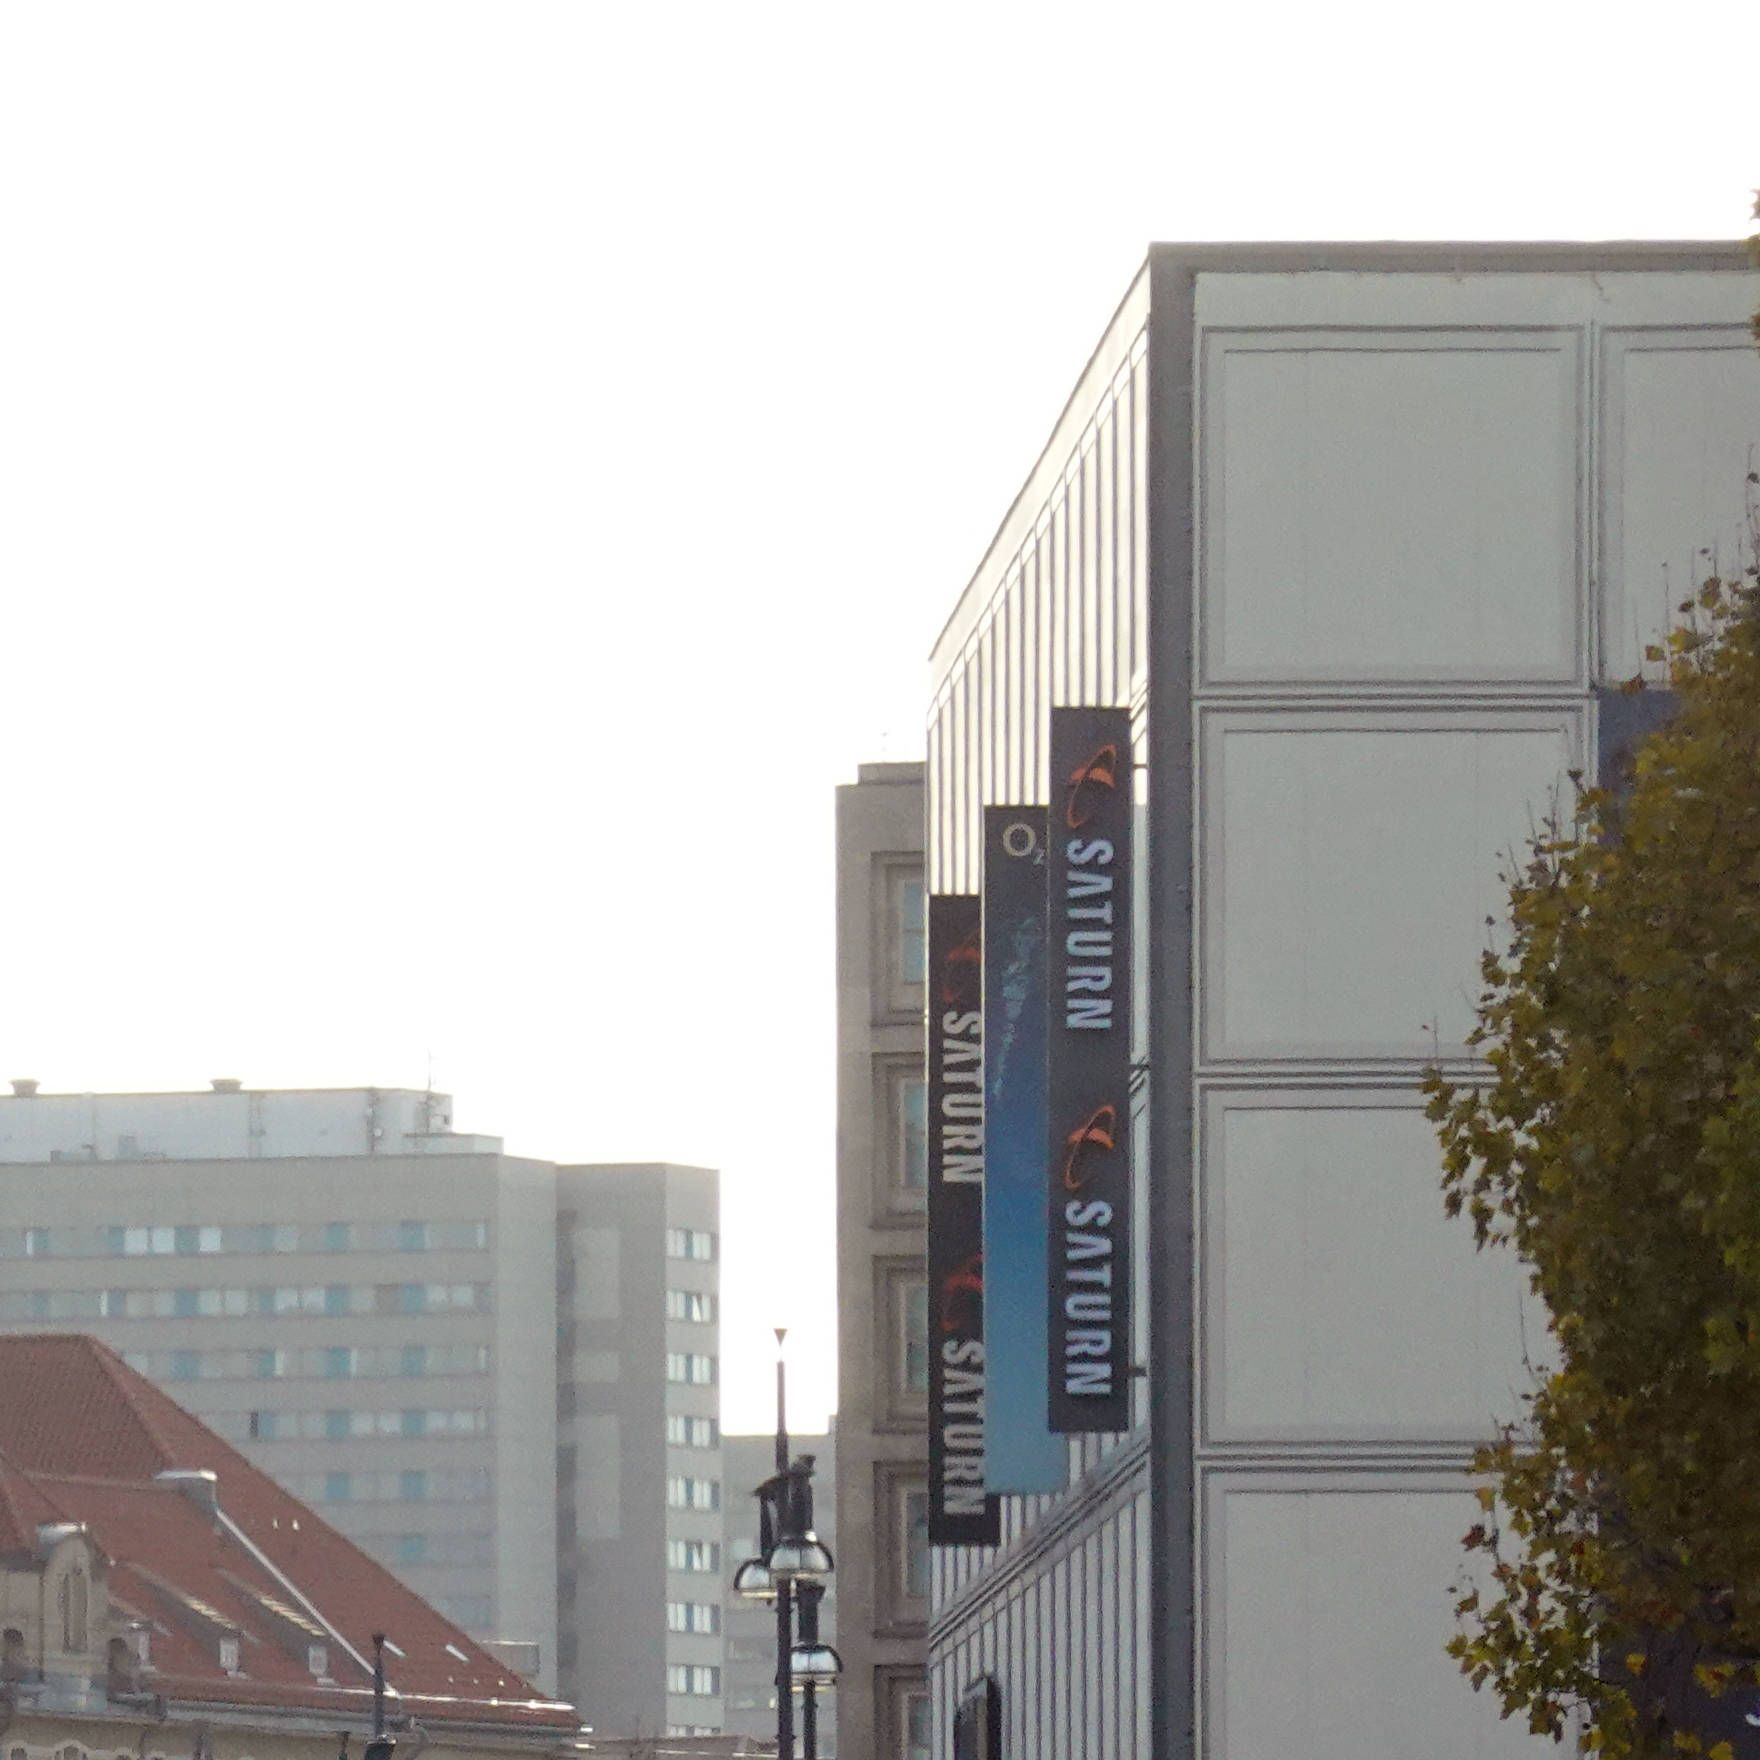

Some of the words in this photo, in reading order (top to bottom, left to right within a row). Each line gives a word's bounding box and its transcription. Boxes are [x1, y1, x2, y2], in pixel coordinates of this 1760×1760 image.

[1065, 839, 1114, 1030] SATURN
[942, 1010, 982, 1184] SATURN
[1065, 1200, 1113, 1395] SATURN
[942, 1339, 985, 1515] SATURN
